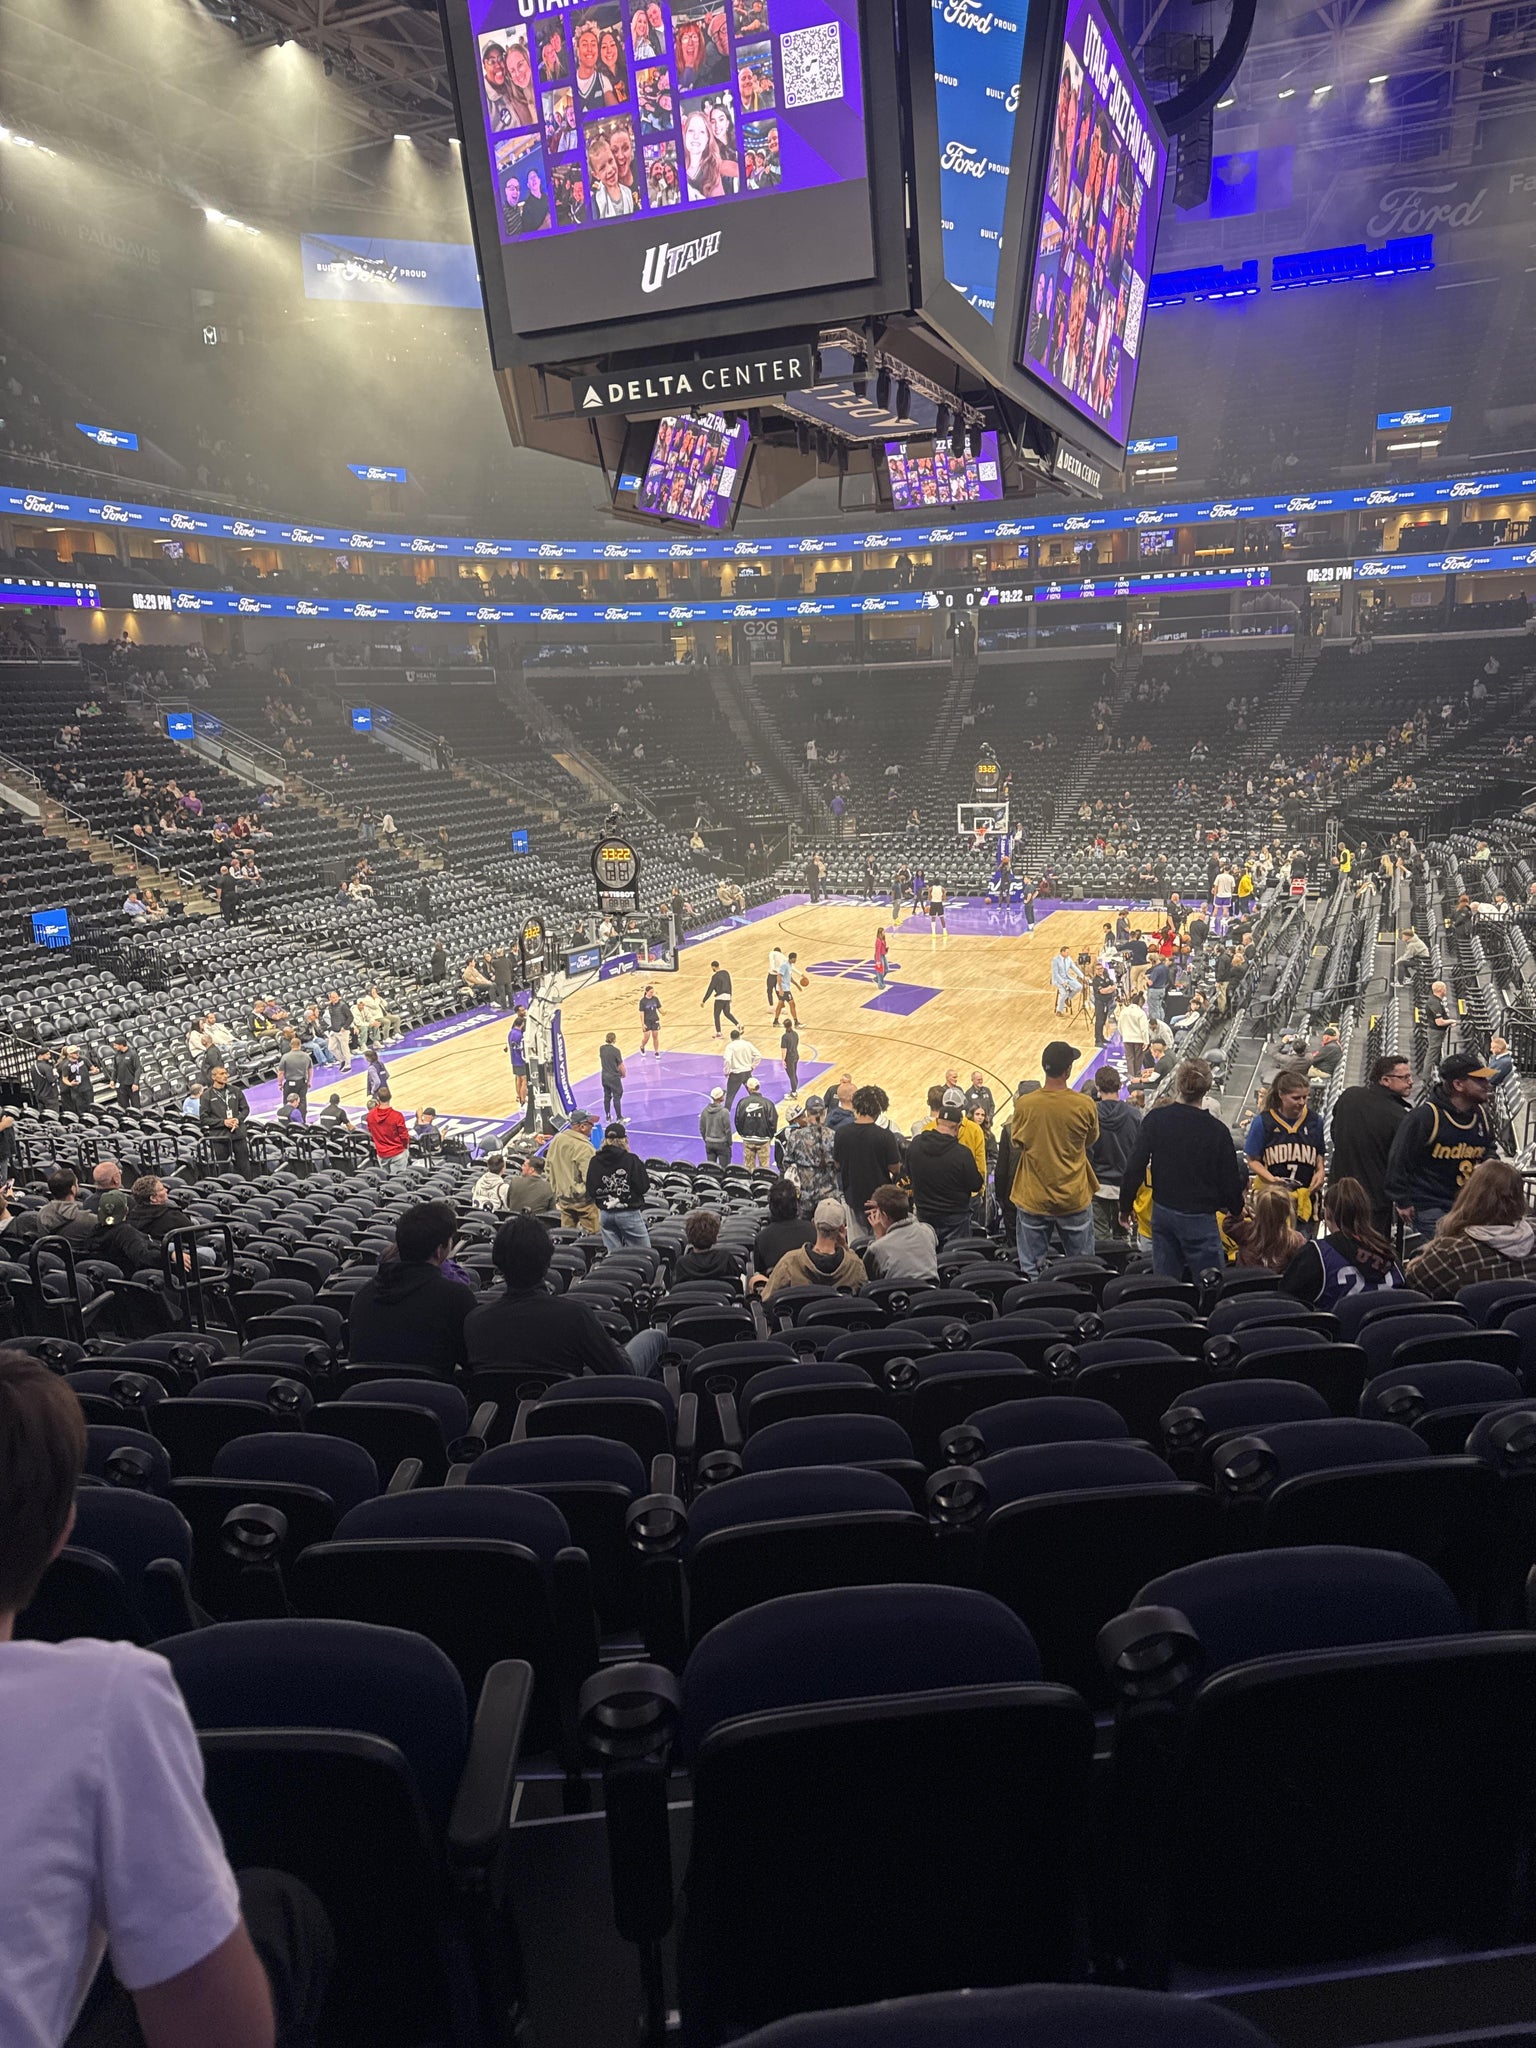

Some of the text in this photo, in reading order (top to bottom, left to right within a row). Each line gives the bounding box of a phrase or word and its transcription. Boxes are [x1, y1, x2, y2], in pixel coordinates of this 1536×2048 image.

[943, 0, 993, 34] Ford
[994, 17, 1017, 33] PROUD
[934, 72, 958, 87] PROUD
[986, 87, 1006, 100] BUILT
[1083, 13, 1108, 100] UTAH
[1126, 105, 1143, 163] FAN
[1138, 131, 1156, 189] CAM
[940, 141, 1010, 179] Ford PROUD
[1365, 182, 1489, 238] Ford
[980, 228, 999, 241] BUILT
[641, 230, 722, 293] UTAH
[400, 269, 427, 278] PROUD
[608, 358, 802, 403] DELTA CENTER
[1400, 412, 1427, 425] Ford
[1133, 440, 1156, 453] Ford
[1063, 452, 1101, 489] DELTA CENTER
[1449, 481, 1483, 498] Ford
[23, 494, 55, 514] Ford
[1286, 497, 1318, 512] Ford
[1366, 490, 1399, 505] Ford
[100, 504, 129, 523] Ford
[1135, 510, 1164, 525] Ford
[1209, 503, 1240, 518] Ford
[170, 513, 196, 530] Ford
[1063, 516, 1092, 531] Ford
[232, 522, 256, 536] Ford
[291, 529, 314, 542] Ford
[928, 529, 955, 542] Ford
[994, 523, 1022, 536] Ford
[349, 535, 374, 546] Ford
[411, 539, 436, 550] Ford
[473, 541, 500, 553] Ford
[798, 538, 825, 551] Ford
[864, 534, 890, 548] Ford
[538, 543, 564, 555] Ford
[603, 544, 629, 556] Ford
[668, 543, 694, 557] Ford
[733, 542, 760, 554] Ford
[1358, 562, 1391, 577] Ford
[1441, 555, 1474, 571] Ford
[1306, 566, 1352, 583] 06:29 PM
[132, 593, 172, 611] 06:29 PM
[176, 593, 201, 609] Ford
[945, 594, 954, 607] 0
[966, 593, 974, 606] 0
[999, 589, 1023, 603] 33:22
[237, 597, 260, 613] Ford
[295, 600, 318, 616] Ford
[353, 603, 377, 618] Ford
[732, 604, 758, 617] Ford
[797, 601, 823, 615] Ford
[861, 598, 887, 611] Ford
[413, 605, 439, 620] Ford
[476, 607, 502, 621] Ford
[540, 607, 565, 621] Ford
[604, 607, 629, 621] Ford
[668, 606, 694, 620] Ford
[743, 620, 778, 636] G2G
[978, 765, 996, 773] 33:22
[601, 848, 631, 860] 33:22
[1264, 1142, 1317, 1168] INDIANA
[1431, 1142, 1486, 1160] Indian
[1286, 1163, 1299, 1182] 7
